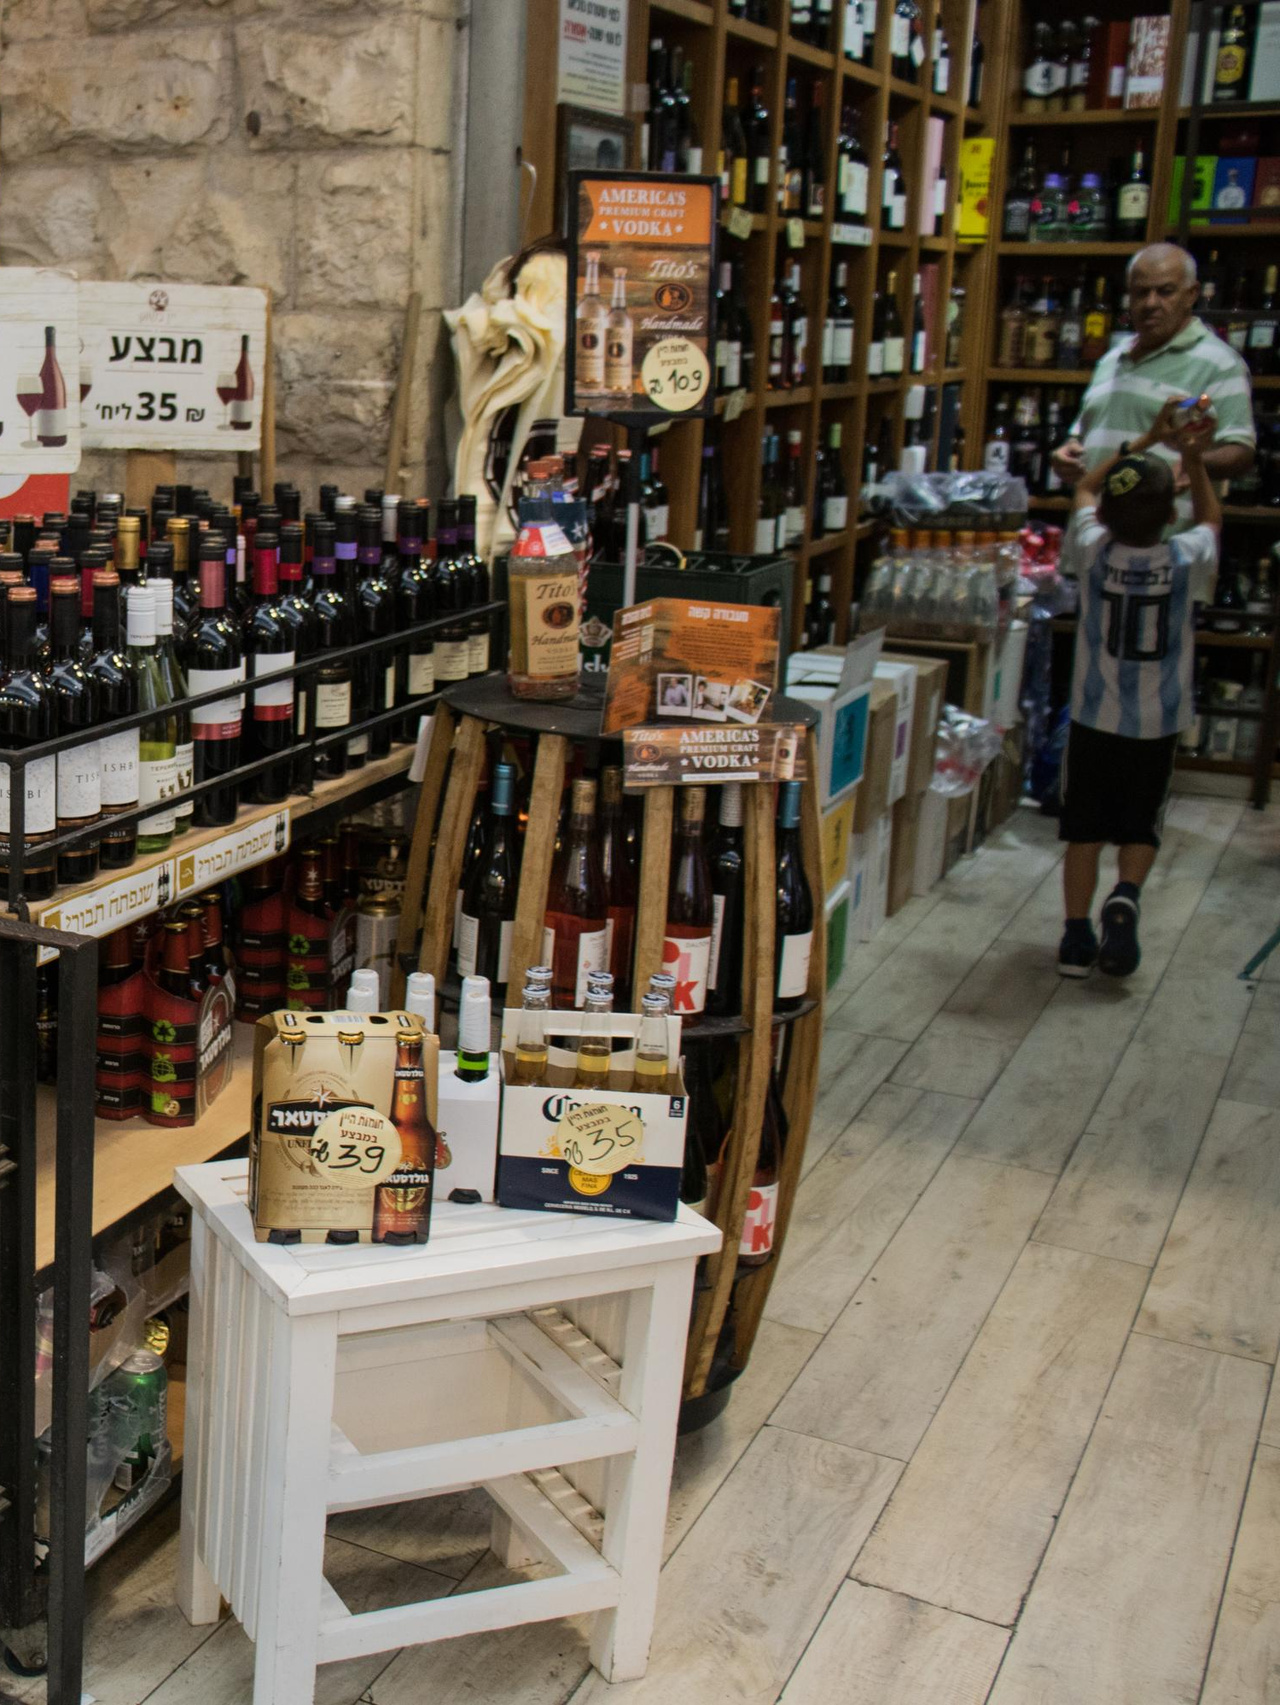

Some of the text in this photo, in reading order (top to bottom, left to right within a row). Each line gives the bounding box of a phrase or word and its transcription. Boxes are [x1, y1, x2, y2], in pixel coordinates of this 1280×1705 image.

[599, 188, 687, 206] AMERICA'S
[599, 205, 686, 218] PREMIUM CRAFT
[612, 219, 673, 236] VODKA
[649, 257, 699, 279] Tito's
[641, 313, 704, 330] Handmade
[109, 336, 202, 364] מבצע
[136, 391, 178, 421] 35
[1101, 591, 1173, 662] 10
[680, 730, 759, 744] AMERICA'S
[680, 744, 759, 754] PREMIUM CRAFT
[691, 755, 752, 769] VODKA
[109, 883, 154, 918] שנפתח
[673, 1100, 681, 1109] 6
[358, 1114, 384, 1129] חומות
[576, 1117, 612, 1132] במבצע
[340, 1129, 378, 1144] במבצע
[586, 1120, 635, 1161] 35
[328, 1144, 386, 1173] 39
[383, 1173, 429, 1184] גולדסטא
